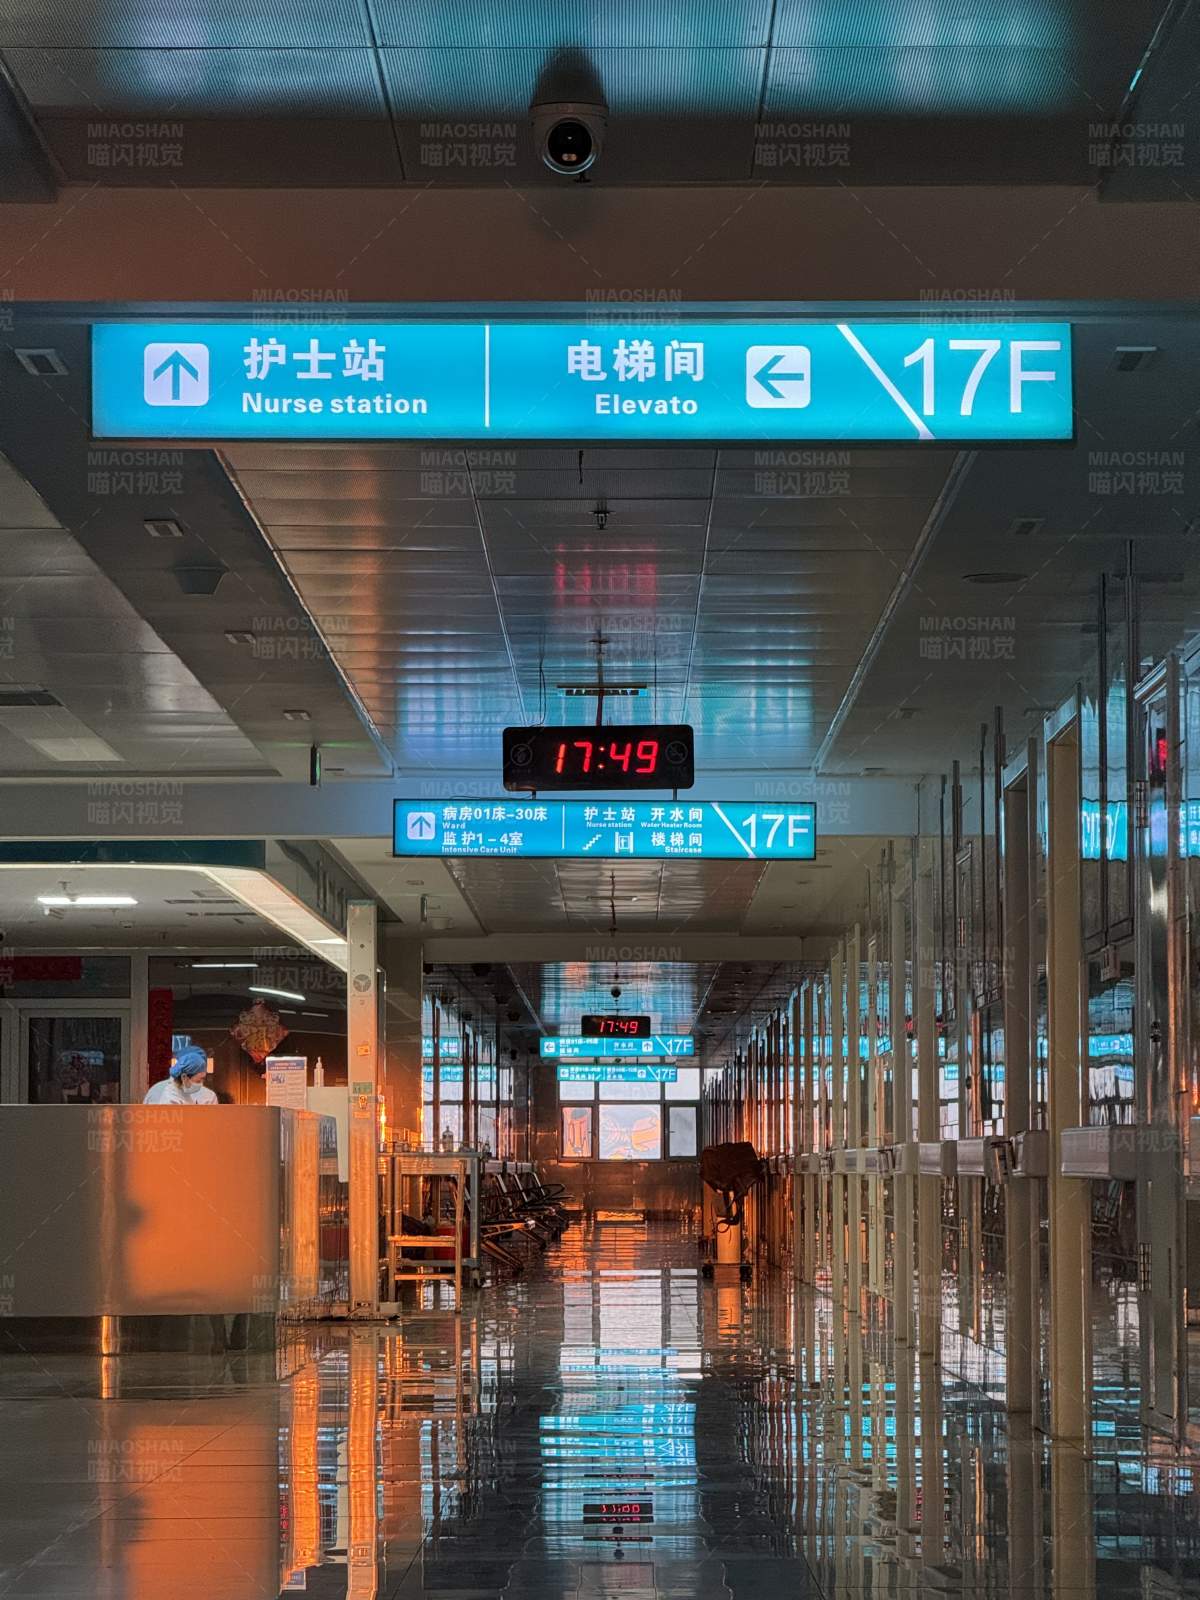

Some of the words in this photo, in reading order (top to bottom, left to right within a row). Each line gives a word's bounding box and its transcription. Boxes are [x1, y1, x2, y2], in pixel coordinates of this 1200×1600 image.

[243, 337, 386, 382] 护士站
[567, 338, 705, 383] 电梯间
[903, 338, 1062, 416] 17F
[242, 392, 323, 414] Nurse
[330, 393, 427, 414] station
[595, 394, 698, 415] Elevato
[554, 740, 660, 774] 17:49
[442, 806, 549, 822] 病房01床-30床
[584, 807, 636, 821] 护士站
[651, 807, 703, 822] 开水间
[442, 822, 466, 830] Ward
[742, 813, 811, 849] 17F
[651, 831, 703, 847] 楼梯间
[664, 846, 702, 854] Staircase
[598, 1020, 638, 1034] 17:49
[667, 1039, 693, 1053] 17F
